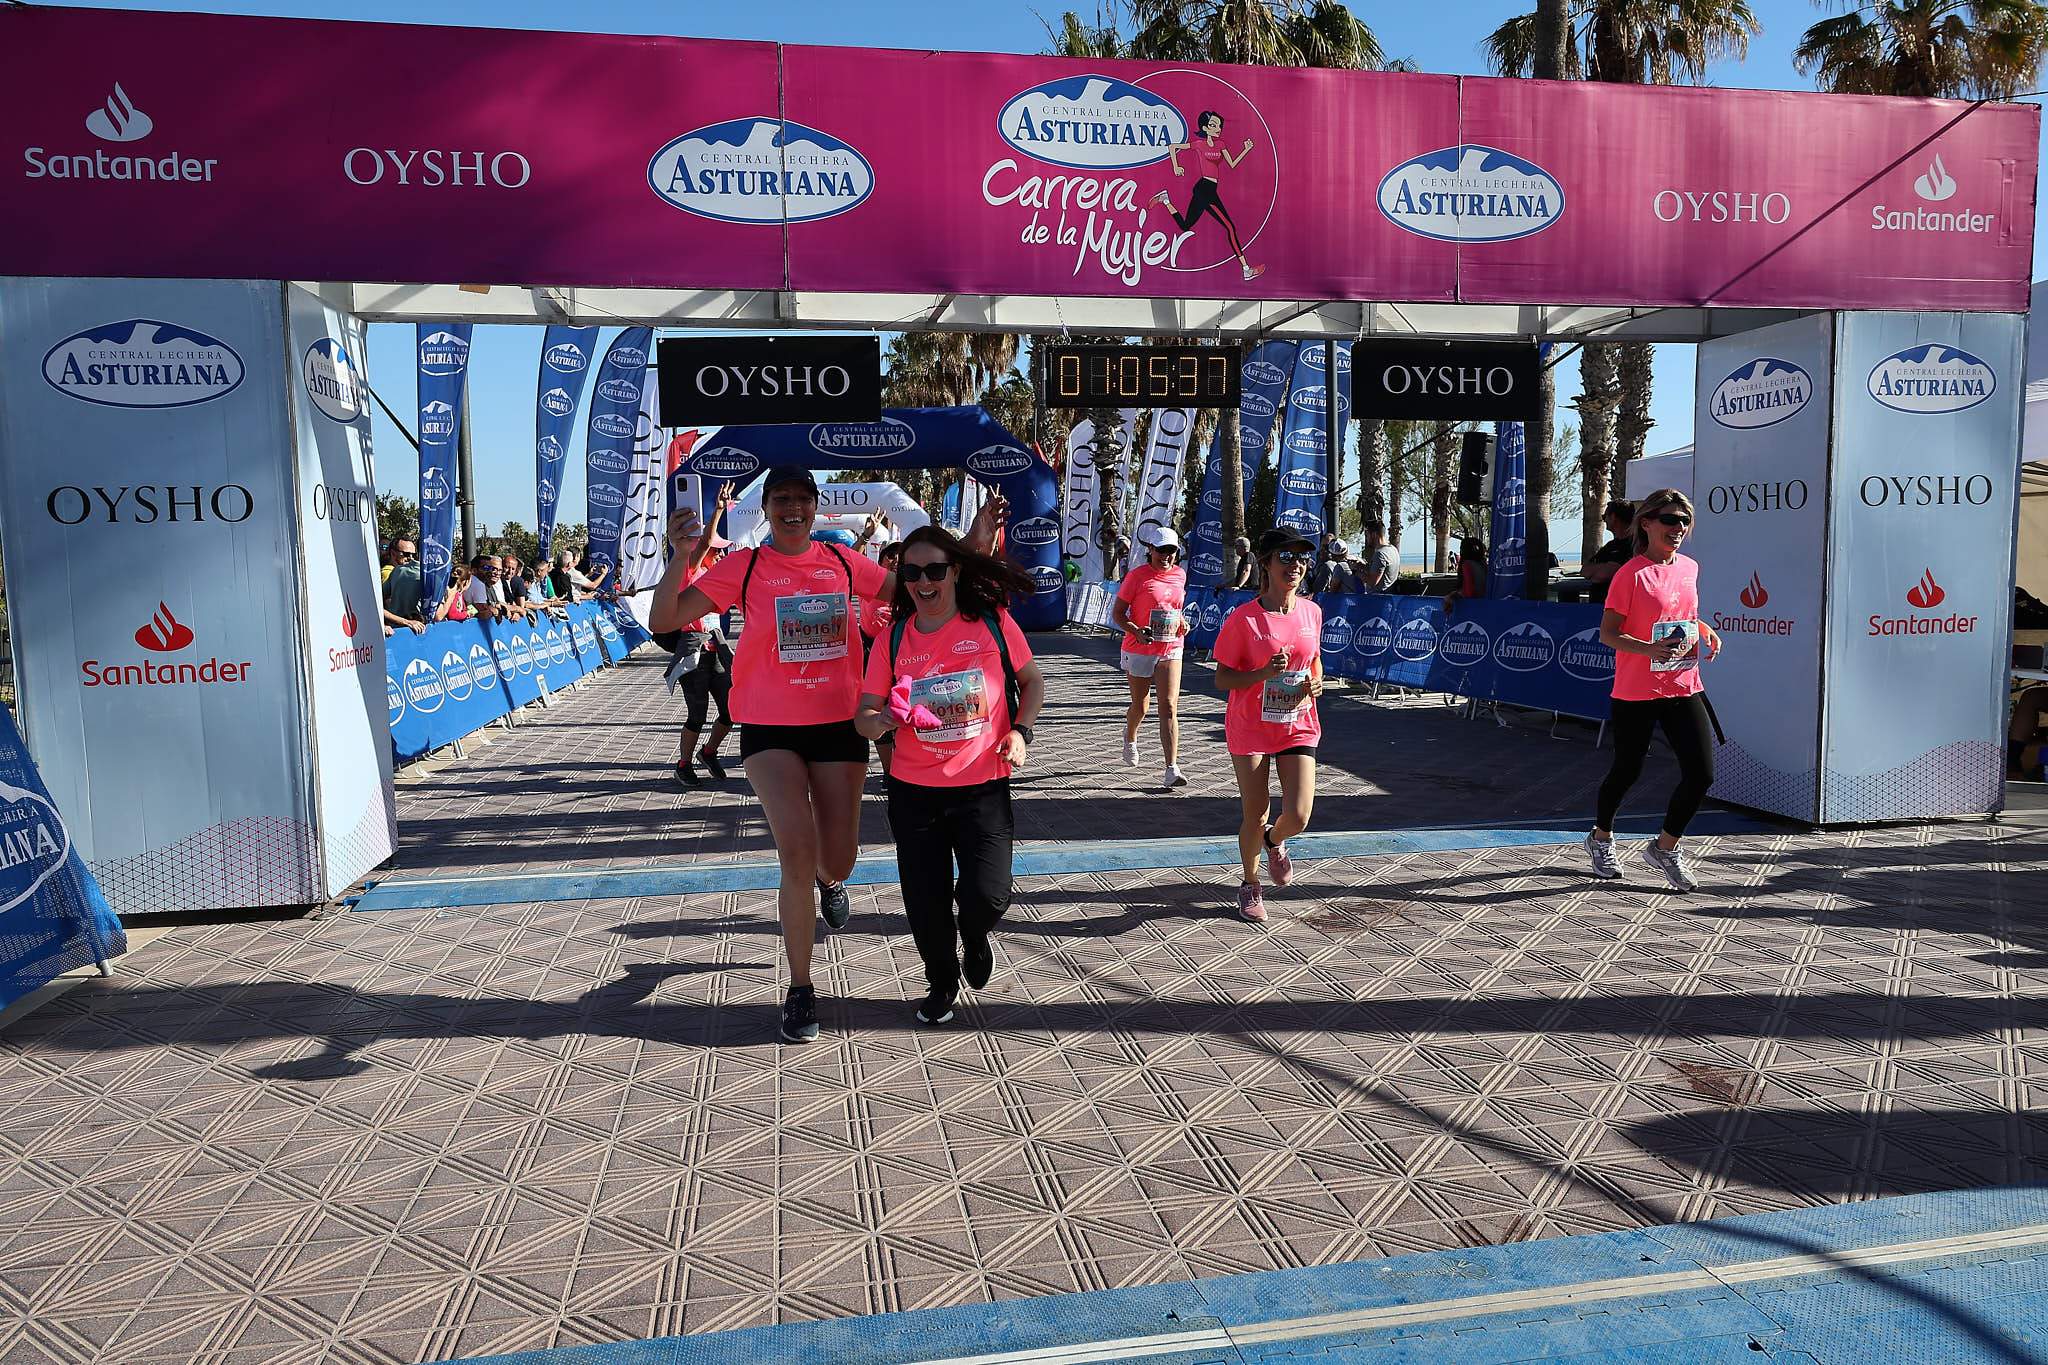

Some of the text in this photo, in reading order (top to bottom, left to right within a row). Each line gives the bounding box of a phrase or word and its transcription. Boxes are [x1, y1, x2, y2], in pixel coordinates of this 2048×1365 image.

[1013, 106, 1172, 147] ASTURIANA
[1042, 105, 1168, 120] CENTRAL LECHERA
[24, 147, 218, 181] Santander
[343, 148, 531, 188] OYSHO
[701, 153, 771, 165] CENTRAL
[666, 154, 858, 197] ASTURIANA
[982, 158, 1138, 212] Carrera
[1421, 177, 1545, 190] CENTRAL LECHERA
[1391, 178, 1550, 218] ASTURIANA
[1653, 190, 1791, 225] OYSHO
[1871, 205, 1995, 234] Santander
[1021, 208, 1195, 287] de la Mujer
[58, 352, 231, 386] ASTURIANA
[89, 351, 223, 360] CENTRAL LECHERA
[696, 365, 850, 397] OYSHO
[1060, 356, 1227, 396] 01:05:37
[1382, 365, 1514, 396] OYSHO
[1731, 376, 1801, 394] CENTRAL LECHERA
[1876, 369, 1986, 396] ASTURIANA
[1896, 368, 1983, 376] CENTRAL LECHERA
[1716, 386, 1804, 417] ASTURIANA
[595, 420, 631, 435] ASTURIANA
[817, 427, 908, 447] ASTURIANA
[591, 455, 626, 470] ASTURIANA
[696, 457, 754, 470] ASTURIANA
[972, 457, 1029, 469] ASTURIANA
[1137, 409, 1188, 546] OYSHO
[1860, 474, 1993, 507] OYSHO
[47, 484, 254, 525] OYSHO
[313, 484, 370, 524] OYSHO
[820, 489, 869, 506] SHO
[1066, 445, 1094, 559] OYSHO
[1708, 480, 1808, 515] OYSHO
[1712, 612, 1795, 636] Santander
[1868, 613, 1978, 636] Santander
[1395, 634, 1433, 651] ASTURIANA
[1442, 636, 1484, 656] ASTURIANA
[1496, 639, 1548, 661] ASTURIANA
[328, 644, 374, 672] Santander
[899, 653, 930, 666] OYSHO
[1562, 645, 1617, 670] ASTURIAN
[82, 657, 251, 687] Santander
